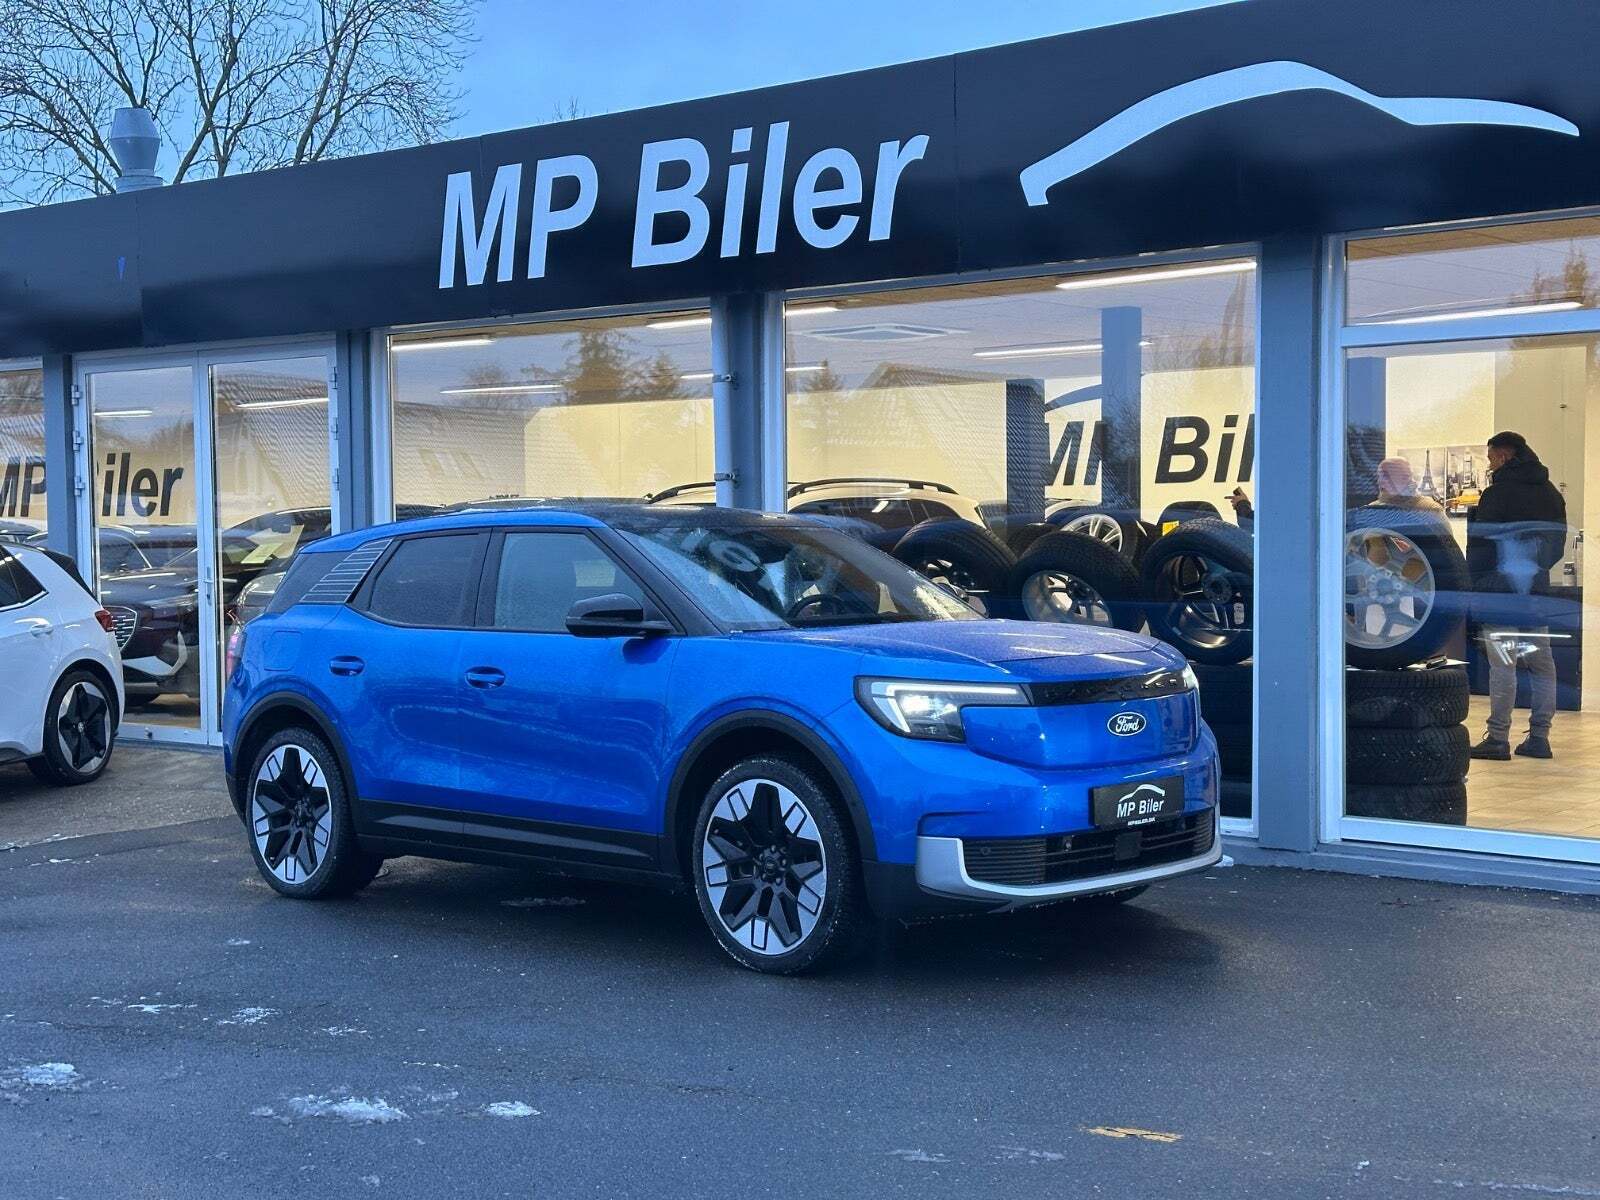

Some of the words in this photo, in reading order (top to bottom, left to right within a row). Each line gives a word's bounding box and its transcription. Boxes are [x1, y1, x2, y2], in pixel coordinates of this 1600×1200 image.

[438, 154, 598, 289] MP
[631, 120, 930, 268] Biler
[97, 452, 184, 517] iler
[1115, 715, 1140, 732] Ford
[1116, 801, 1136, 818] MP
[1138, 798, 1165, 815] Biler
